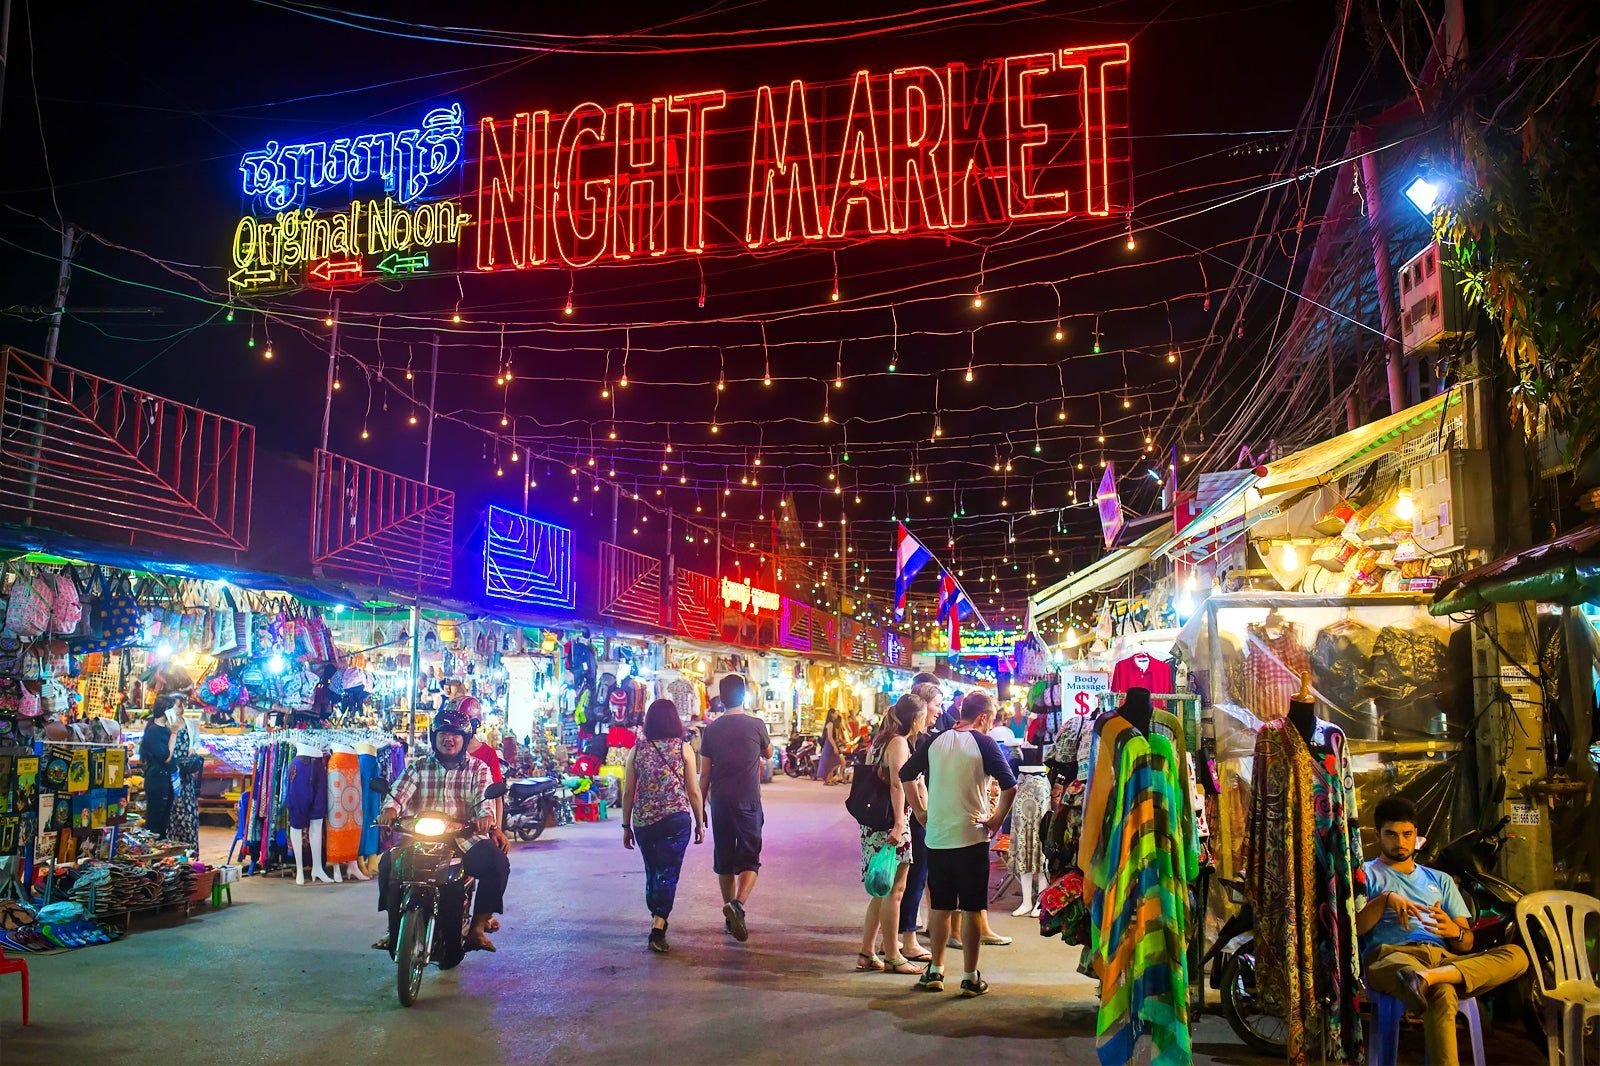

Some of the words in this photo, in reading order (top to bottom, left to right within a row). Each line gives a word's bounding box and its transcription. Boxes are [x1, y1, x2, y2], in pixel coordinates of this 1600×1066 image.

[476, 89, 727, 271] NIGHT
[745, 42, 1131, 249] MARKET
[232, 199, 361, 269] Original
[1066, 682, 1107, 692] Massage
[1074, 675, 1099, 685] Body
